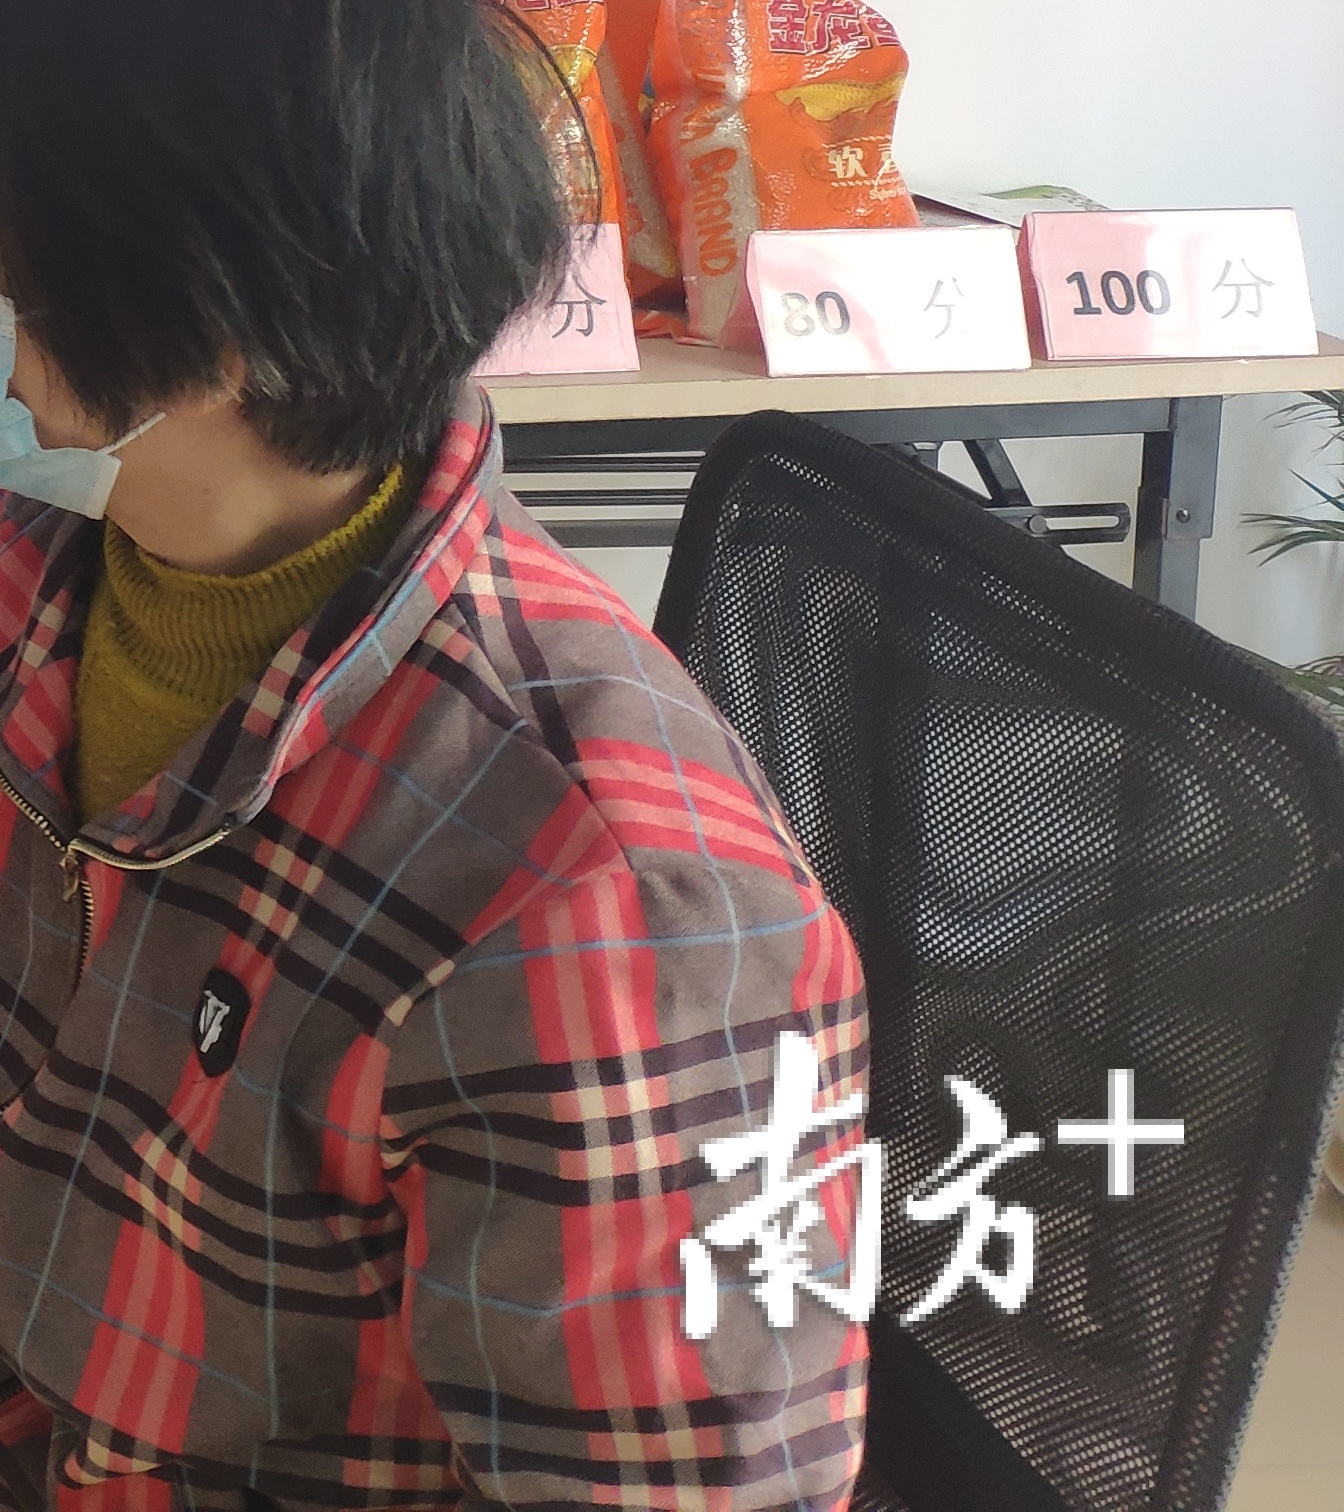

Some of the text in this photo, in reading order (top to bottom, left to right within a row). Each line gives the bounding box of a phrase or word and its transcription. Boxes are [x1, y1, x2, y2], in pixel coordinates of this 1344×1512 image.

[552, 273, 607, 338] 分
[780, 290, 852, 337] 80
[1065, 257, 1277, 319] 100 分
